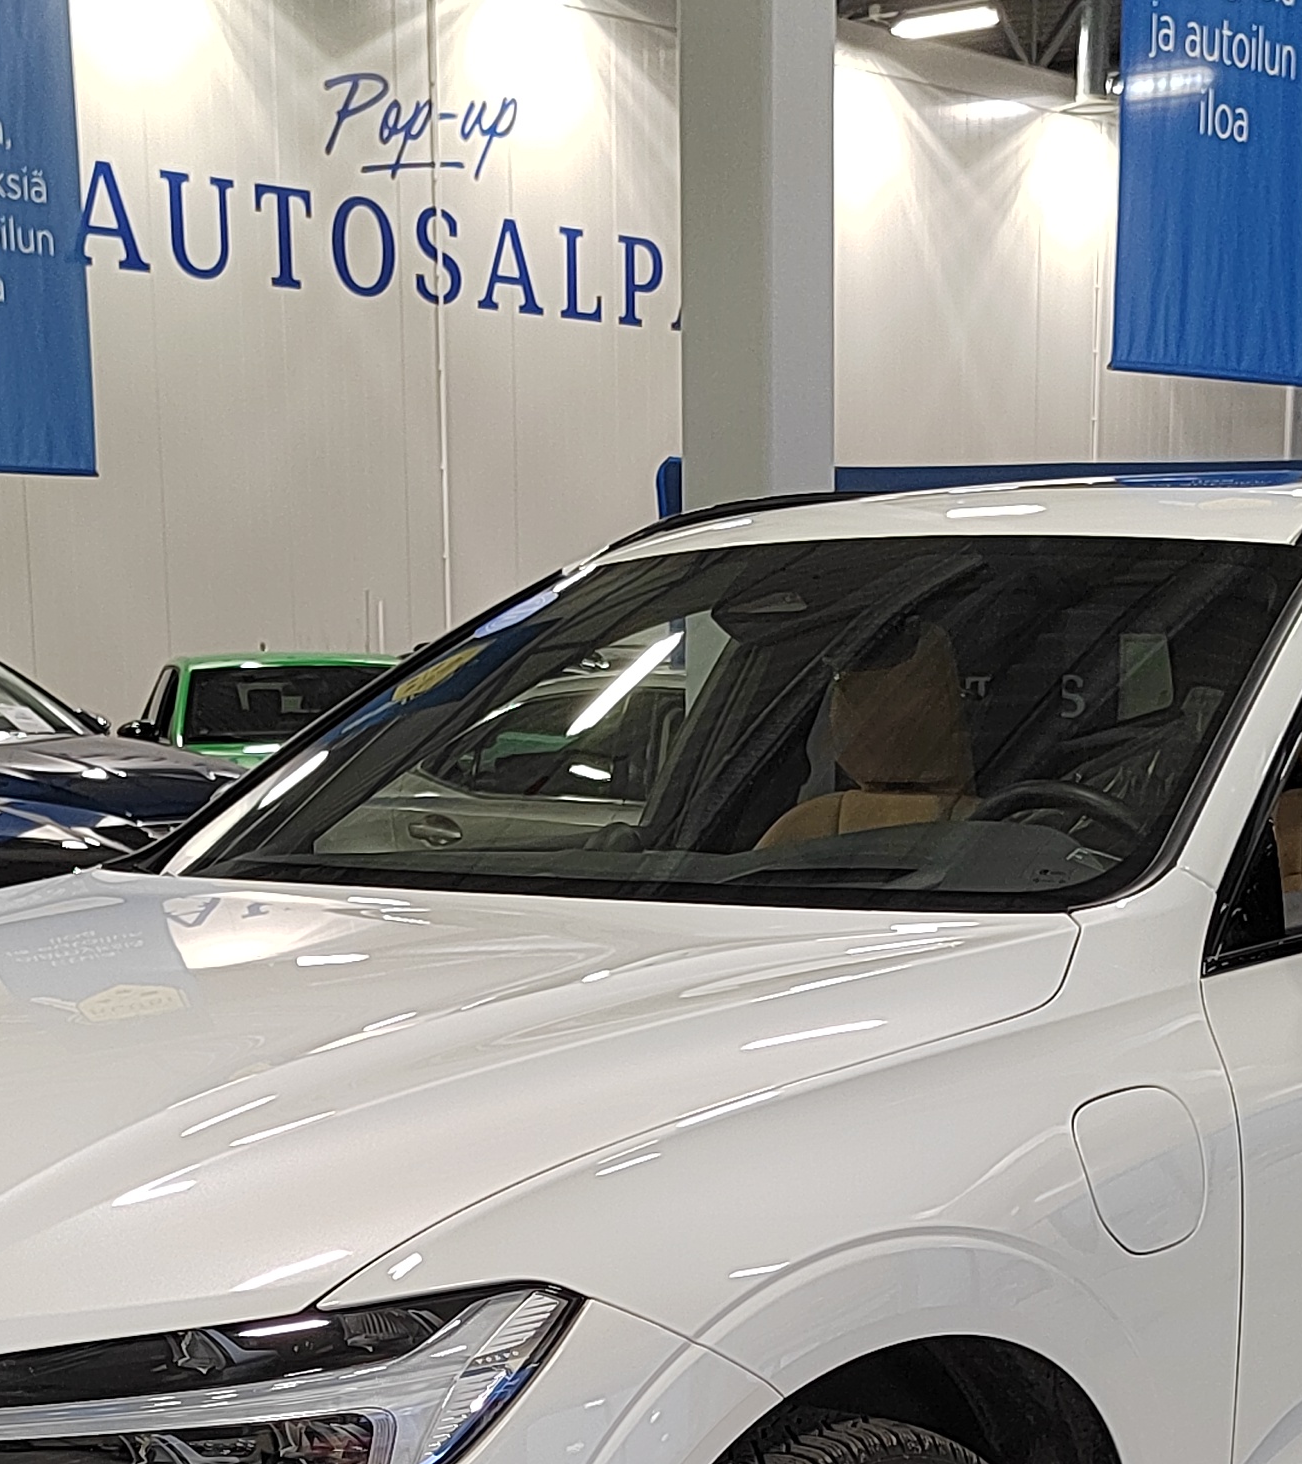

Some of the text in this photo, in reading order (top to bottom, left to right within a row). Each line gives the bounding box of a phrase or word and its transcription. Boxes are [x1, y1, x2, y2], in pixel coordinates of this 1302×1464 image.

[1149, 0, 1297, 80] ja autoilun
[324, 73, 517, 180] Pop-up
[1200, 83, 1249, 143] iloa
[78, 160, 682, 331] AUTOSALP
